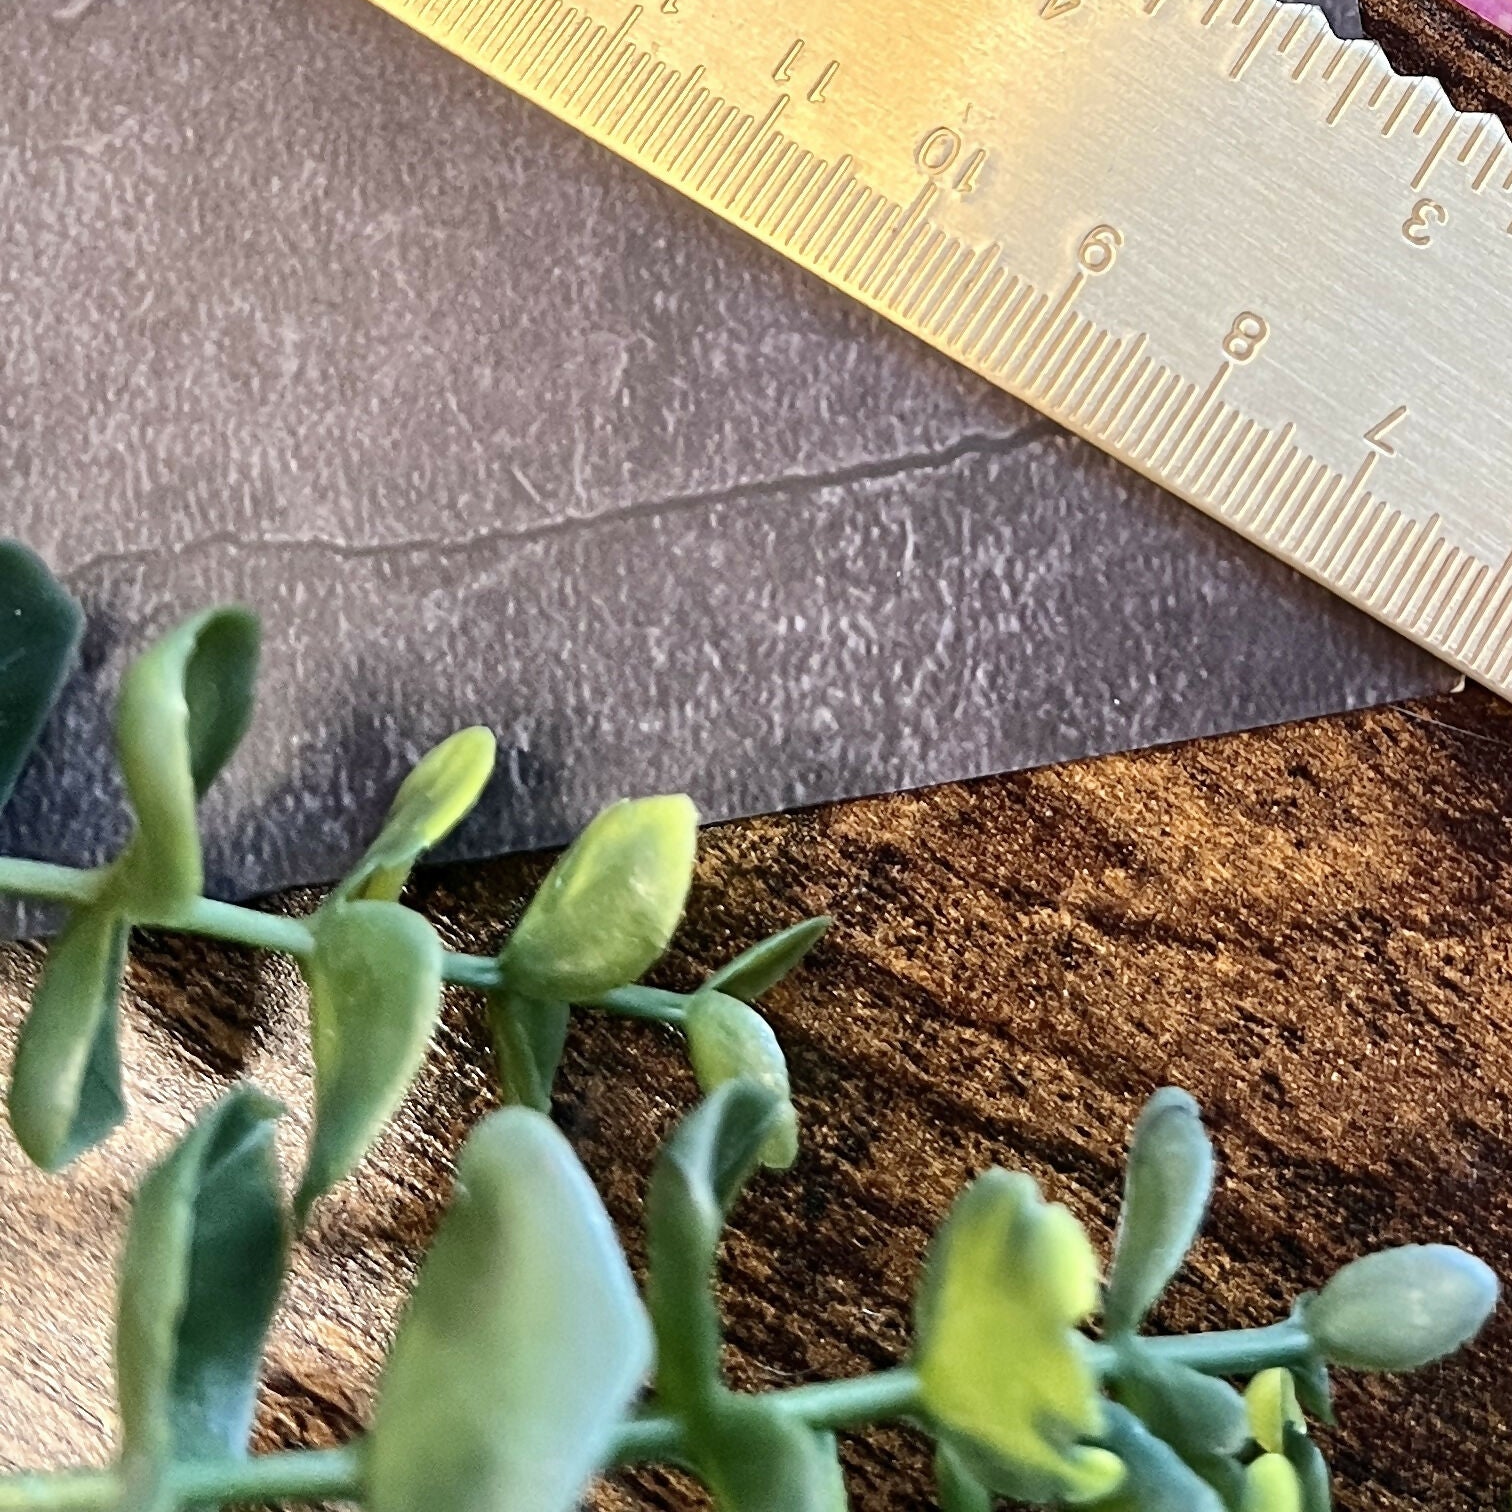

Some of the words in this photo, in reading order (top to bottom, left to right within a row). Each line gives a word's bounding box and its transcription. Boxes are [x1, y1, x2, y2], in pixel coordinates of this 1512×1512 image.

[772, 39, 840, 103] 11
[917, 127, 986, 192] 10
[1402, 198, 1448, 247] 3
[1078, 224, 1124, 274] 9
[1223, 311, 1269, 362] 8
[1363, 405, 1407, 455] 7
